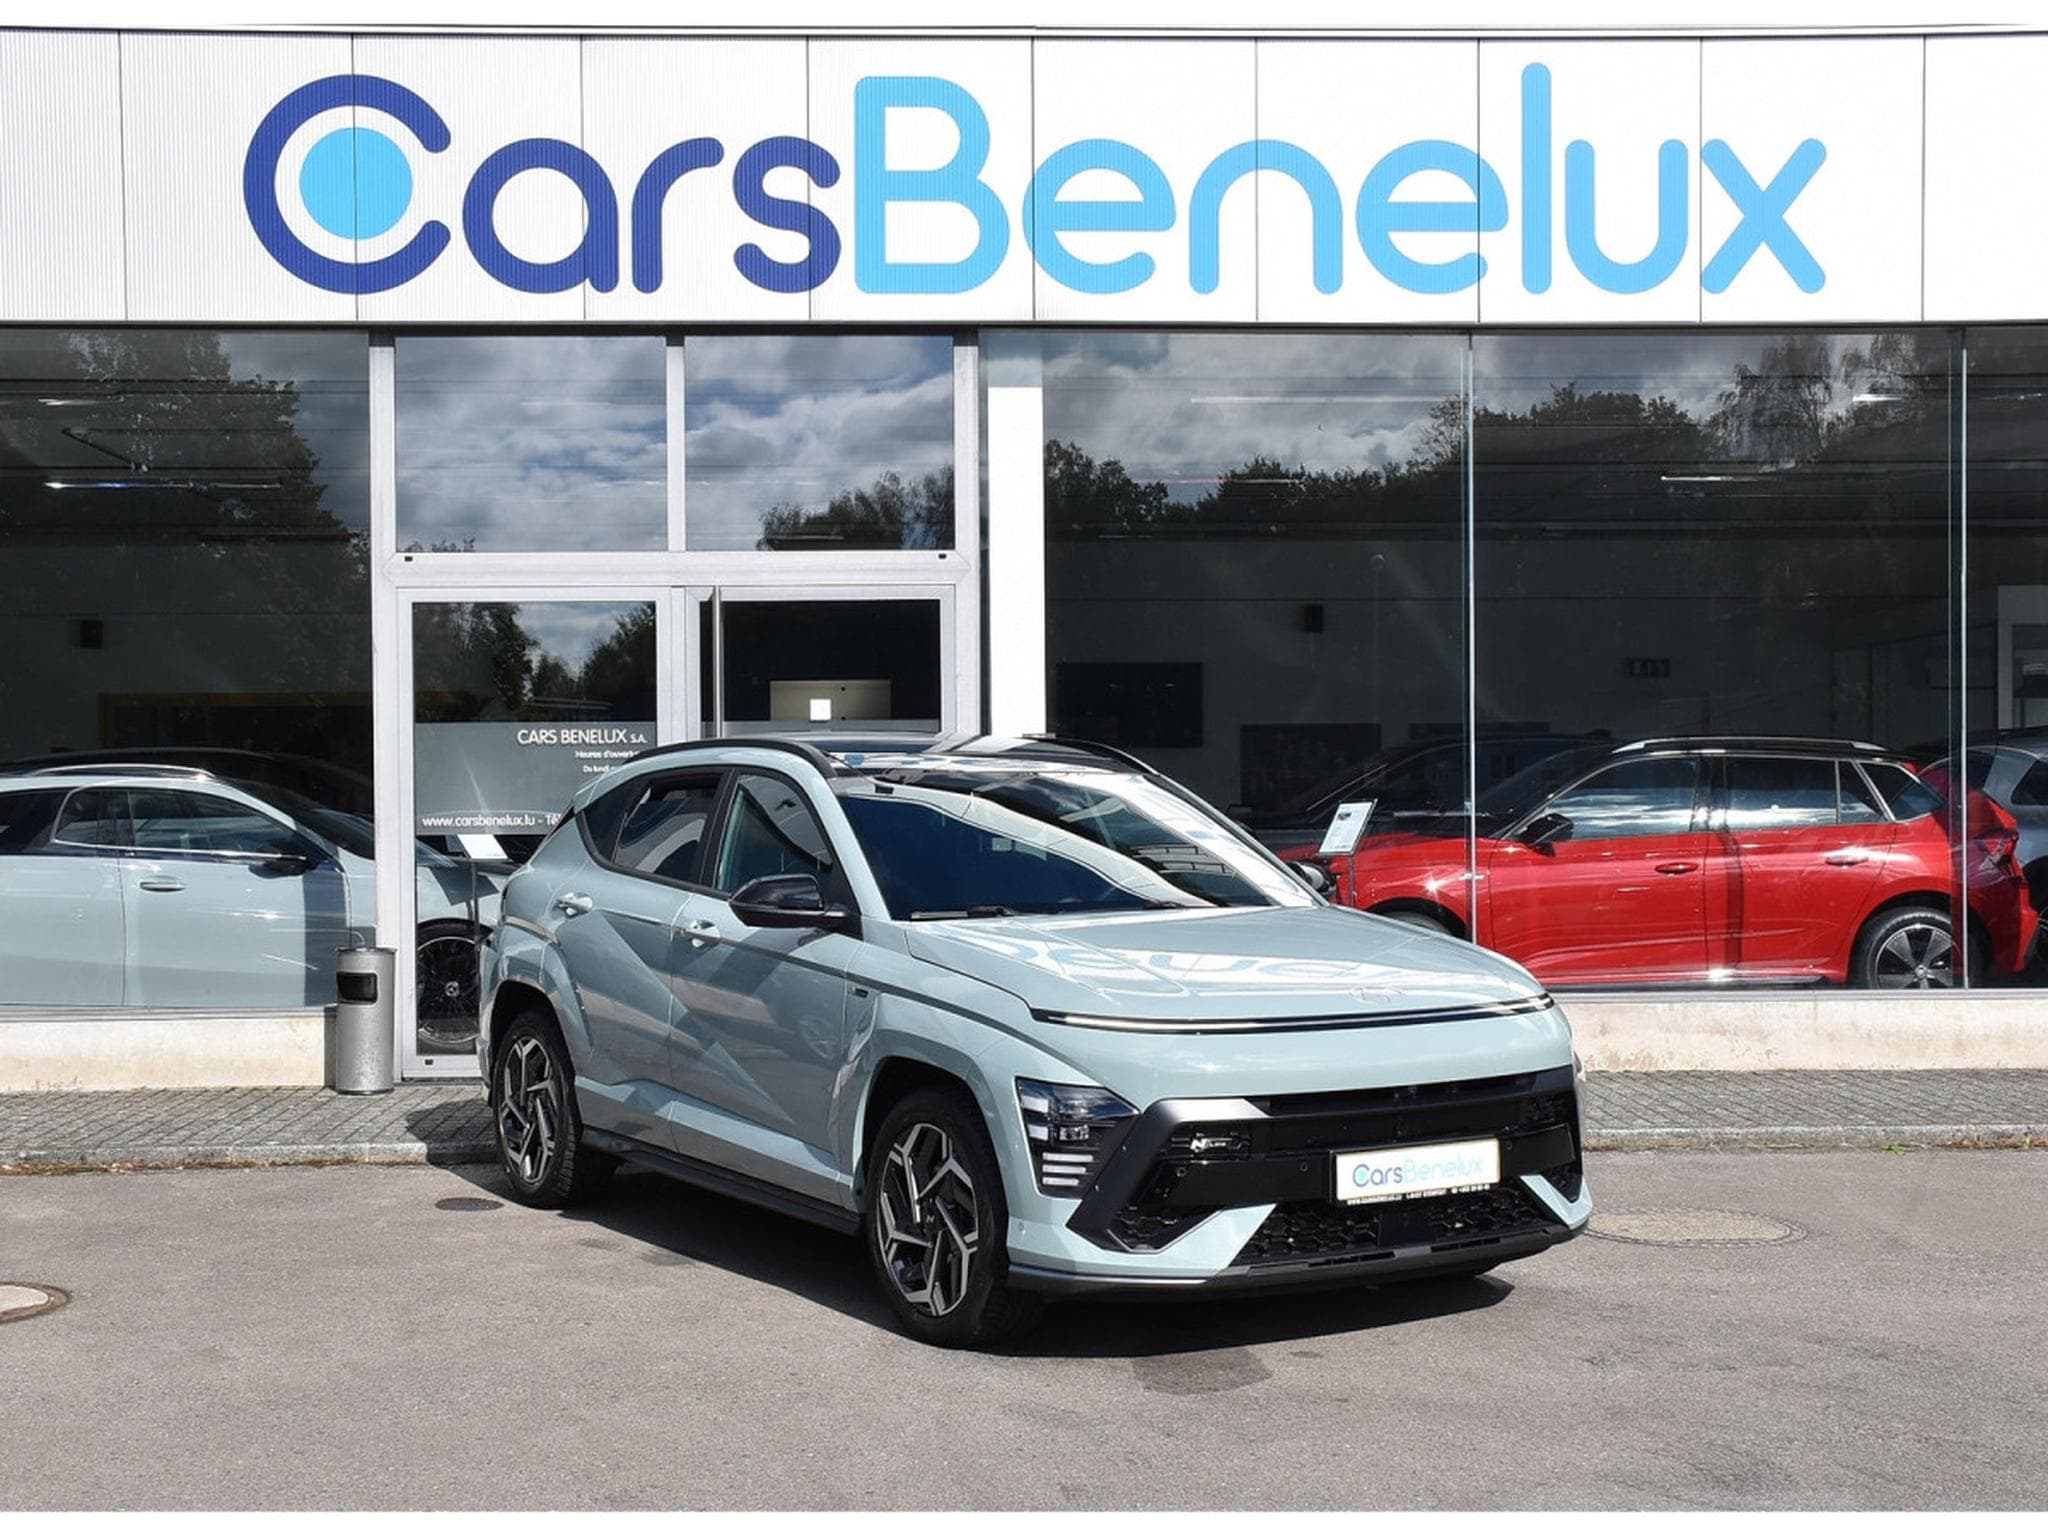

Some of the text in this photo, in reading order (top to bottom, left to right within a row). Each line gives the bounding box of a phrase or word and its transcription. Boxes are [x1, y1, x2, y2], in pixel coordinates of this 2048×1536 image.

[243, 63, 1827, 294] CarsBenelux
[517, 729, 557, 744] CARS
[561, 729, 628, 744] BENELUX
[422, 814, 535, 827] www.carsbenelux.lu
